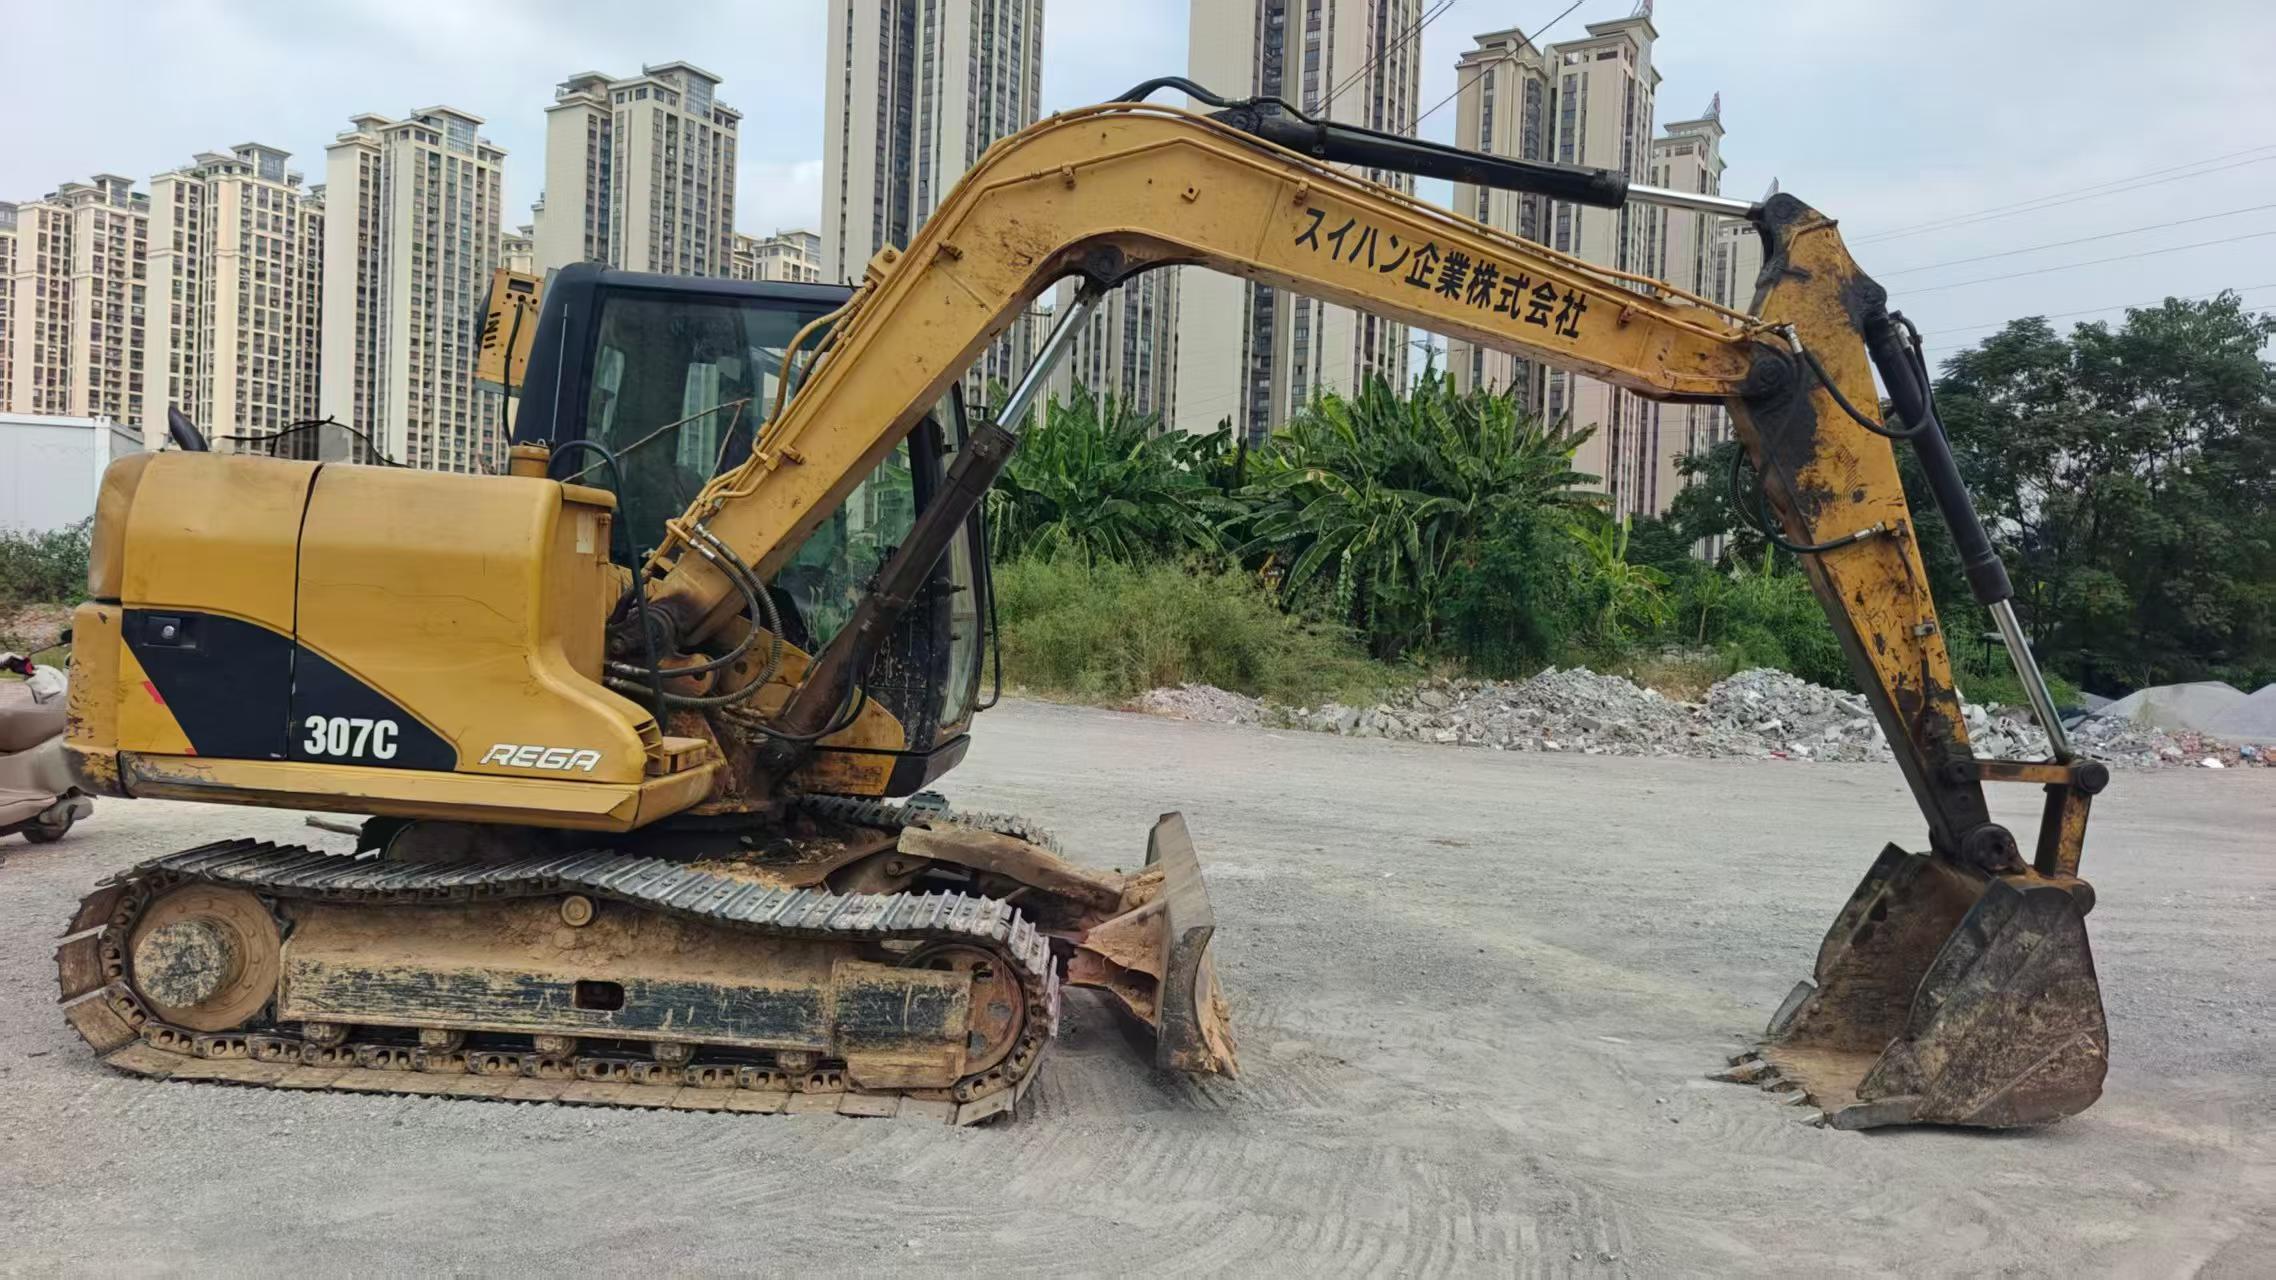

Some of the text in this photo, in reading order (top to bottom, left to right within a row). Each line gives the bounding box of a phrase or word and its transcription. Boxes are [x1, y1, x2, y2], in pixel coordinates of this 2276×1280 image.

[1295, 208, 1587, 338] スイハン企業株式会社
[304, 715, 398, 759] 307C
[480, 744, 601, 772] REGA
